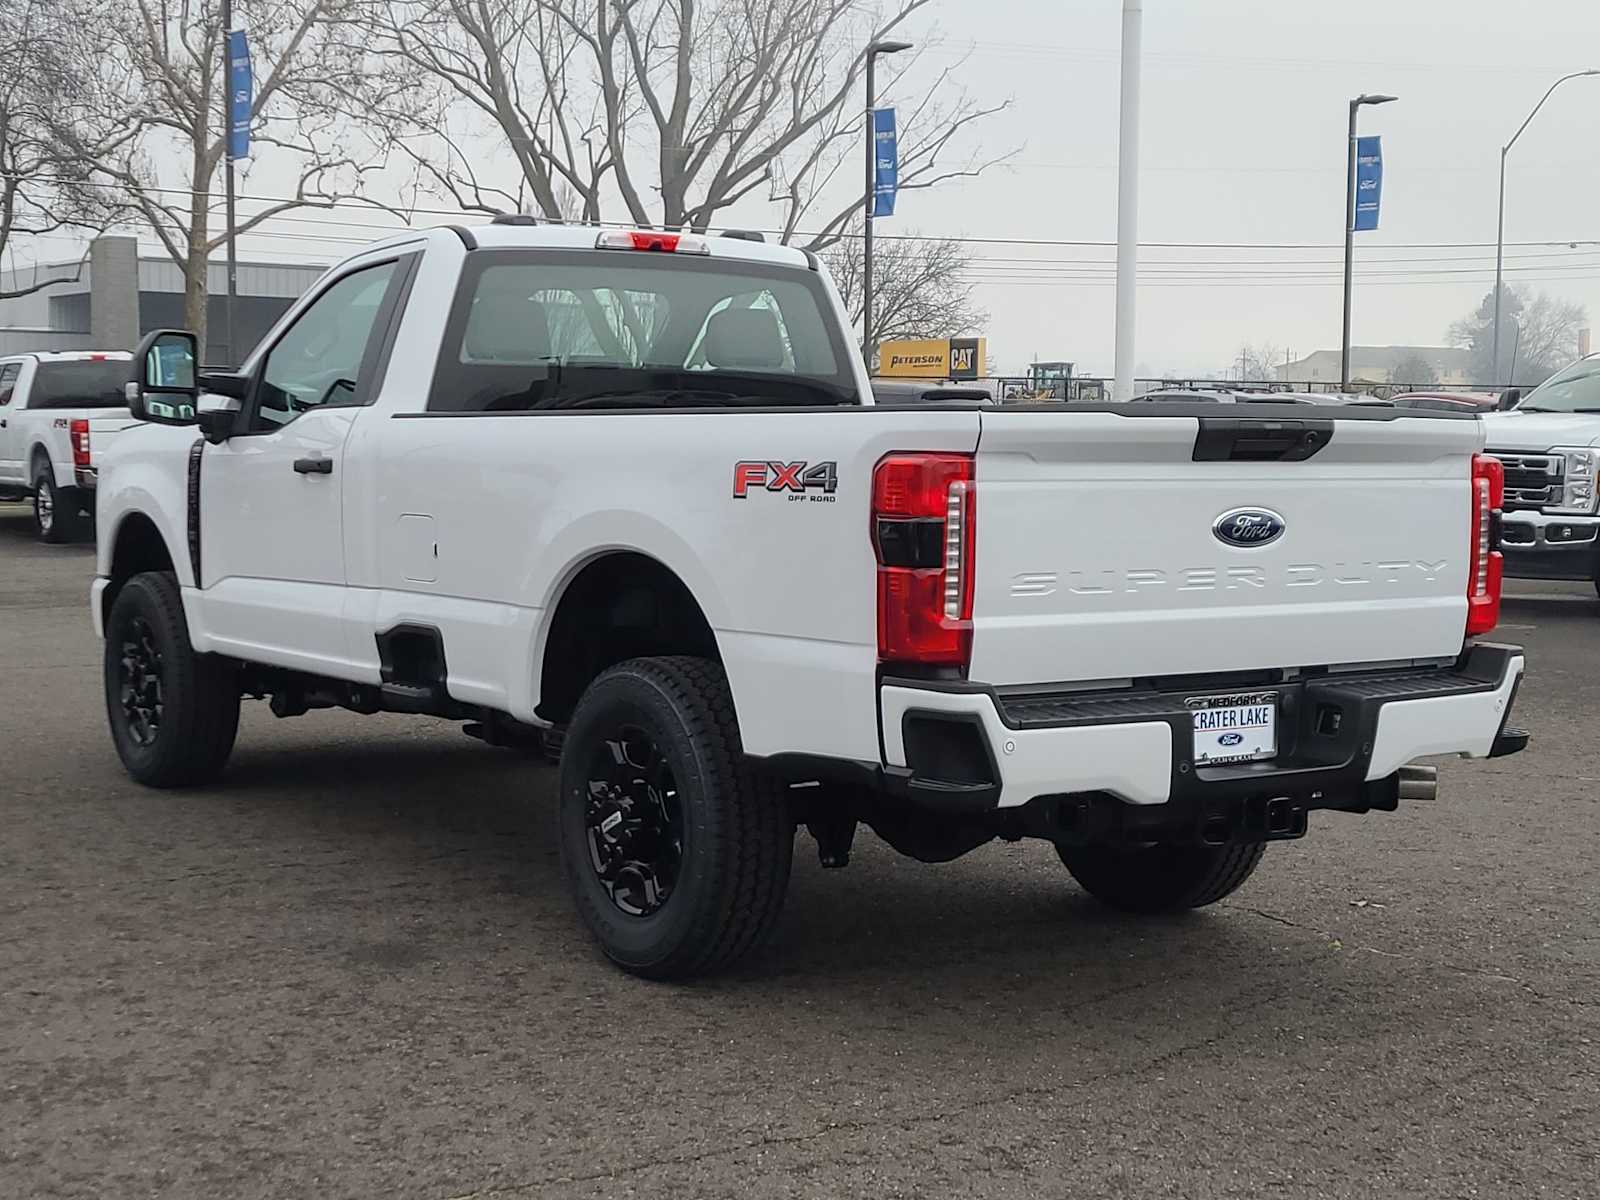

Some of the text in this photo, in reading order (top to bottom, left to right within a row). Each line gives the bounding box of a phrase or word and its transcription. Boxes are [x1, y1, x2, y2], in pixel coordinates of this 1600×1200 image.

[890, 355, 943, 369] PETERSON
[951, 348, 974, 370] CAT
[733, 460, 838, 499] FX4
[788, 495, 836, 503] OFF ROAD
[1232, 515, 1272, 538] Ford
[1010, 559, 1449, 597] SUPER DUTY
[1208, 696, 1256, 708] MEDFORD
[1240, 707, 1268, 726] LAKE
[1222, 734, 1240, 745] Ford
